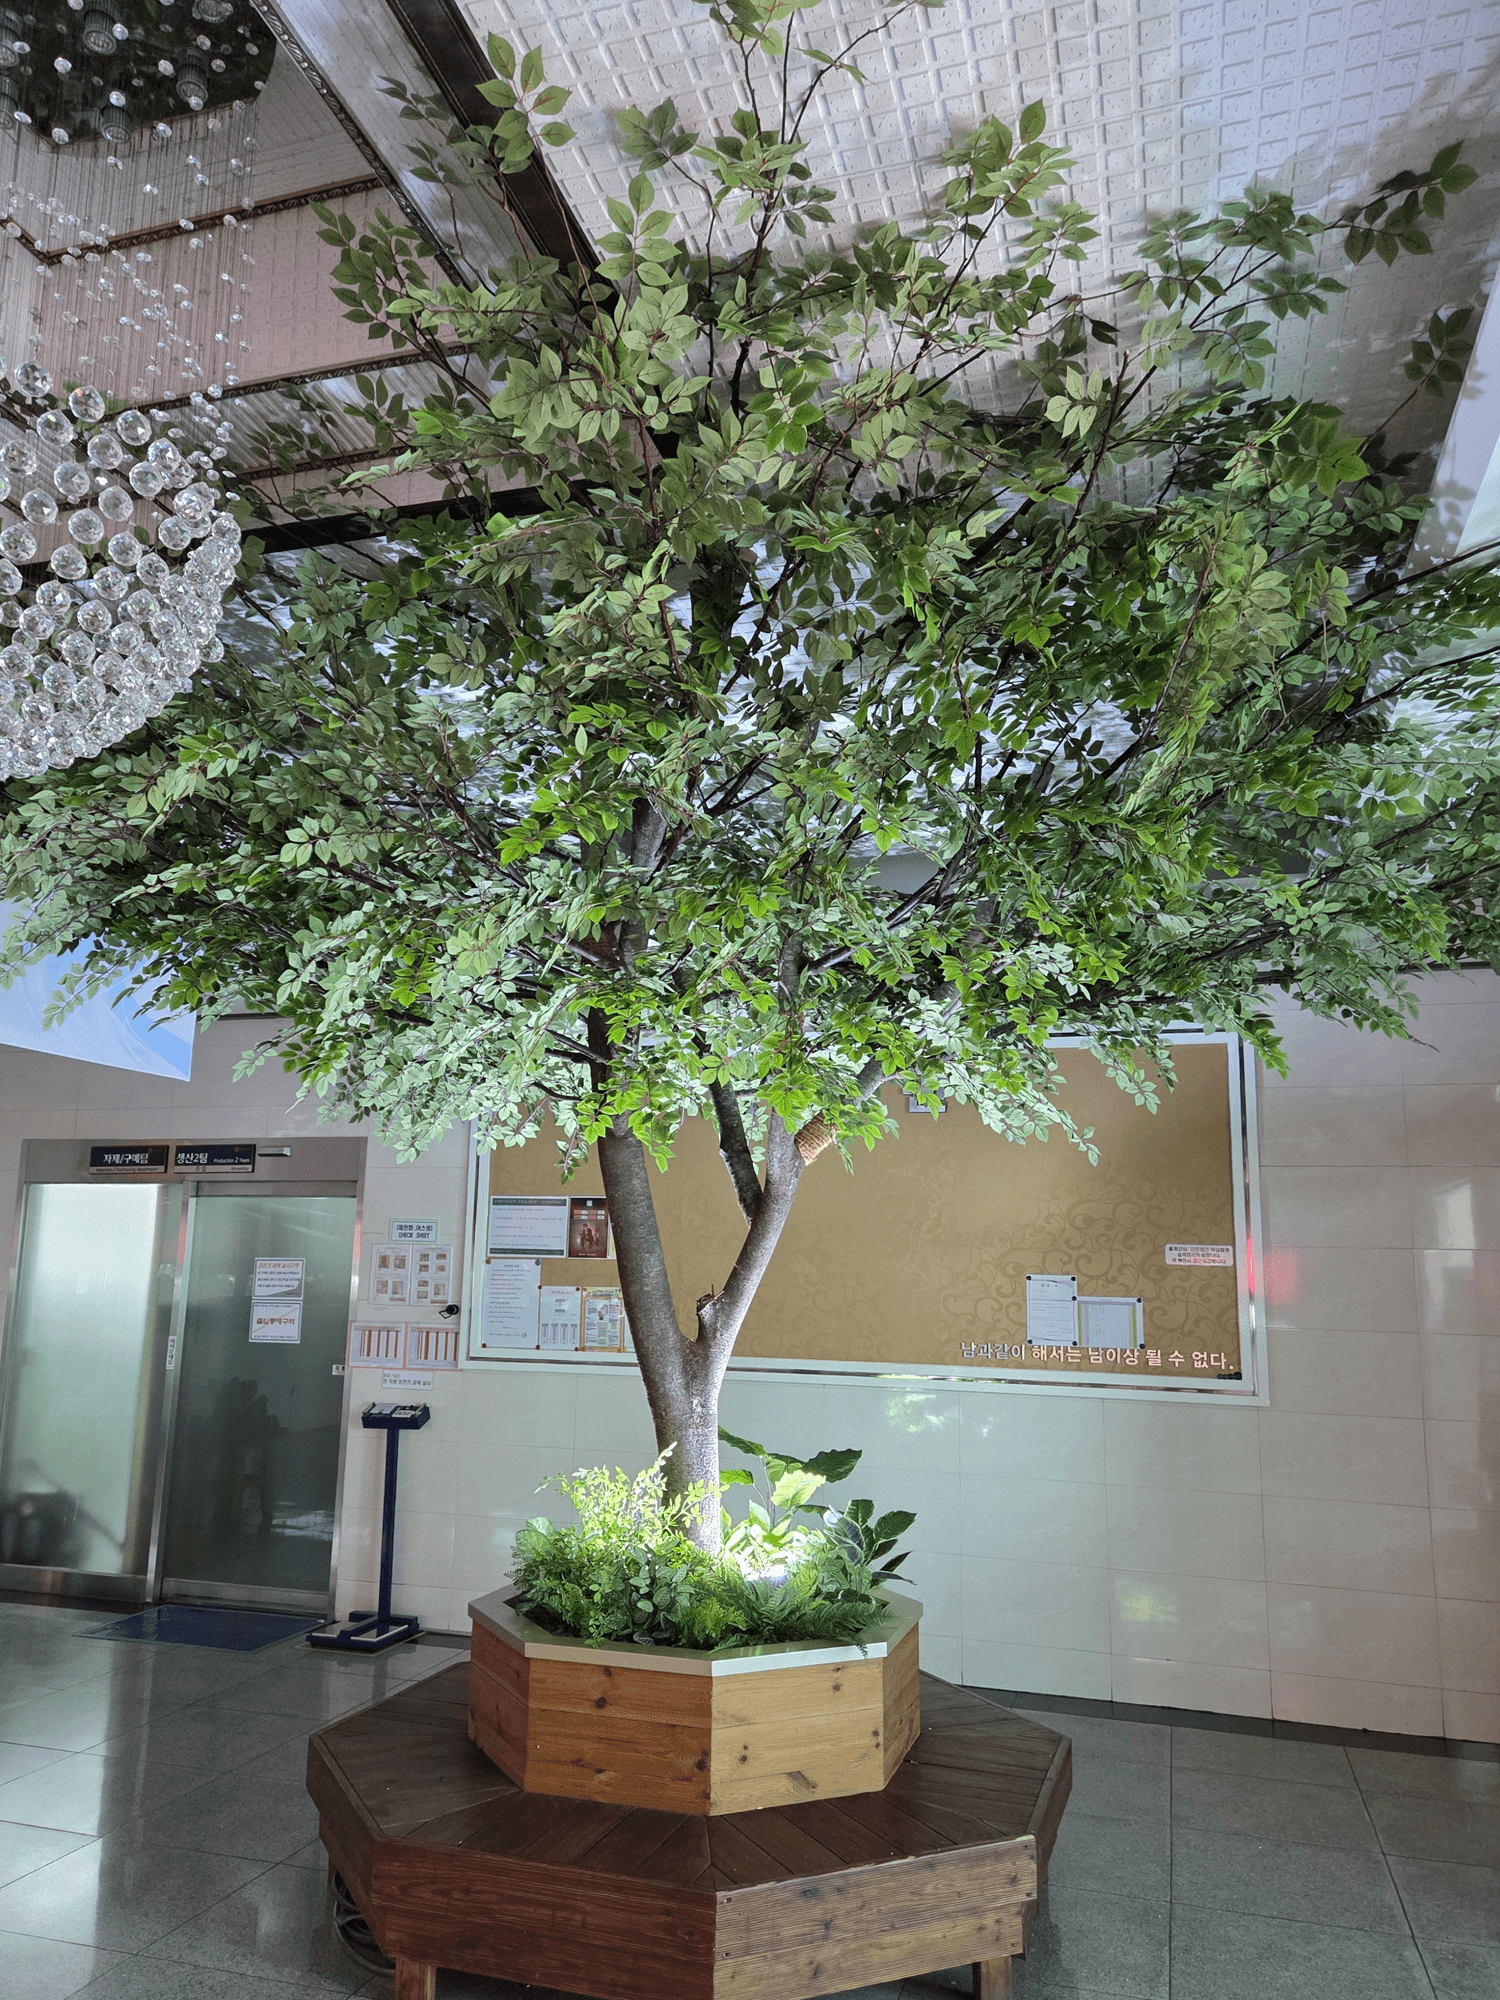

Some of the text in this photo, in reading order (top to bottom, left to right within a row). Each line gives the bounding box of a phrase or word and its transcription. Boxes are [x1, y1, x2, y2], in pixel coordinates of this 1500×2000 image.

[103, 1152, 149, 1165] 자재/구매팀
[176, 1152, 208, 1164] 생산2팀
[960, 1342, 1235, 1370] 남과같이 해서는 남이상 될 수 없다.
